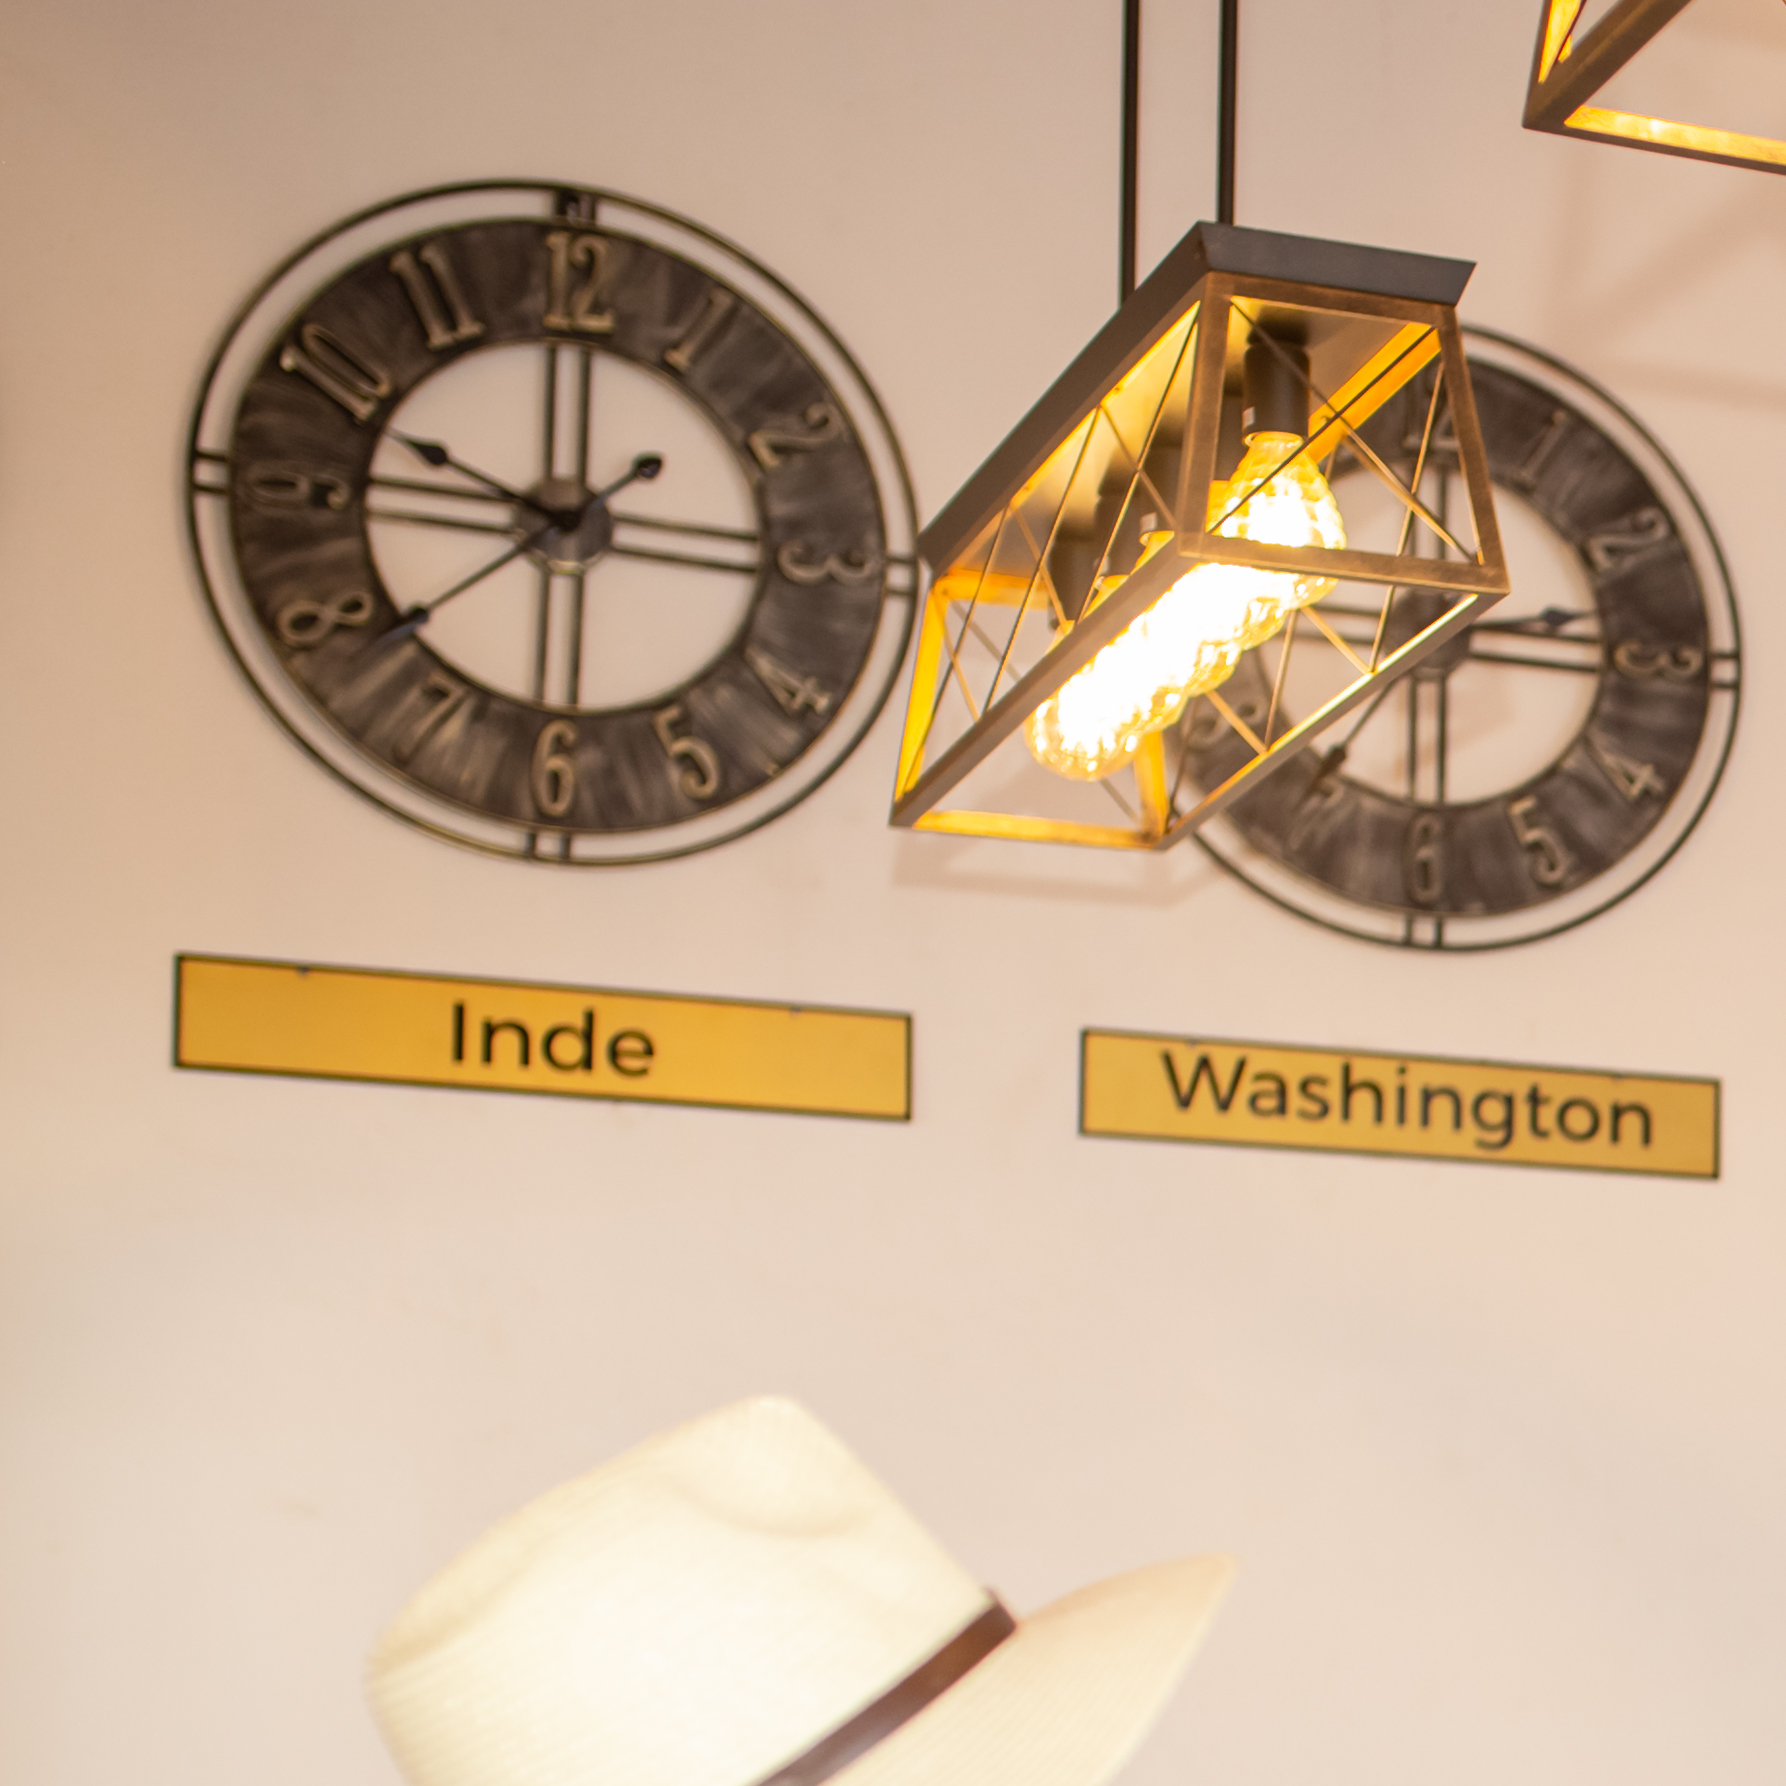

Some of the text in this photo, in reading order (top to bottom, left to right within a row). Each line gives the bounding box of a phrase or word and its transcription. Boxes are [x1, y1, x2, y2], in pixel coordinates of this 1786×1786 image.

[390, 244, 486, 349] 11
[541, 231, 616, 335] 12
[662, 285, 735, 373] 1
[279, 321, 394, 425] 10
[748, 404, 842, 474] 2
[1512, 409, 1571, 486] 1
[251, 462, 349, 511] 9
[776, 543, 878, 586] 3
[1583, 504, 1668, 571] 2
[276, 590, 374, 646] 8
[1613, 635, 1702, 681] 3
[396, 676, 468, 763] 7
[745, 646, 833, 715] 4
[530, 719, 577, 817] 6
[652, 704, 720, 800] 5
[1583, 727, 1667, 803] 4
[1409, 813, 1444, 899] 6
[1508, 796, 1571, 886] 5
[450, 1000, 655, 1079] Inde
[1161, 1048, 1654, 1151] Washington
